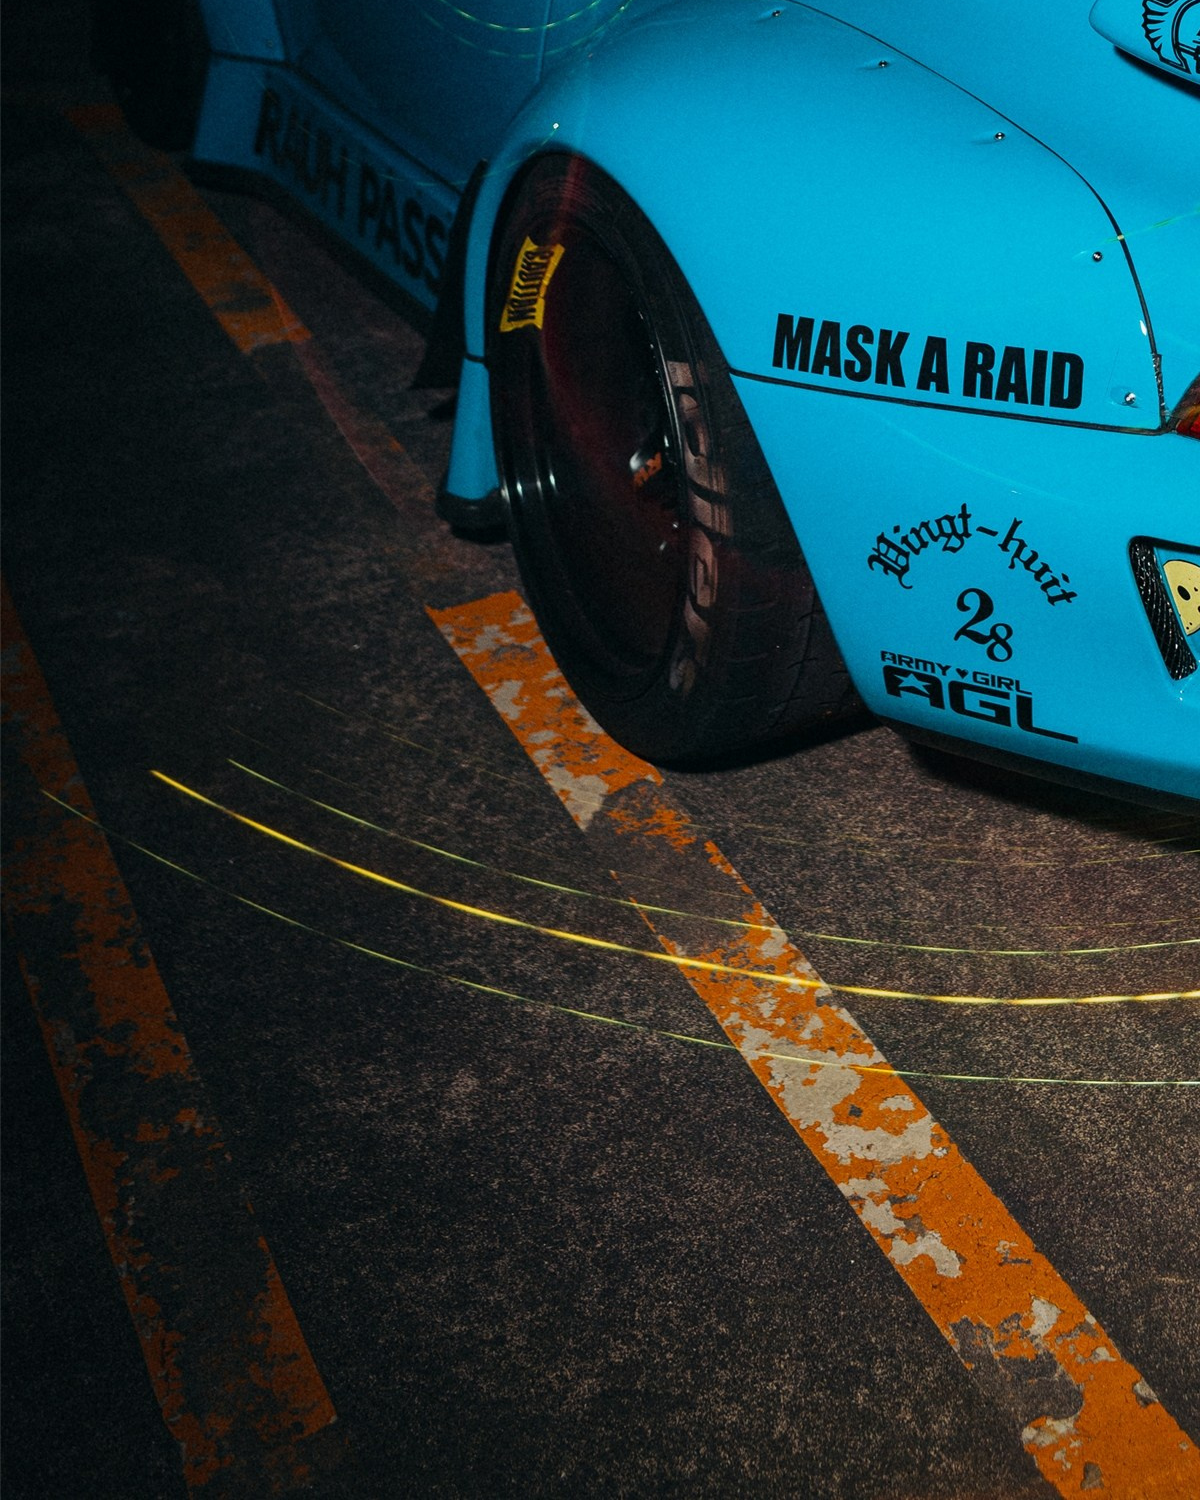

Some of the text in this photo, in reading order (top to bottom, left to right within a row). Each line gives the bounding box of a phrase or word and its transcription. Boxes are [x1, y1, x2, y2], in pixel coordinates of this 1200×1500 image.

[772, 313, 1085, 410] MASK A RAID
[867, 502, 1078, 607] Vingt-huit
[953, 587, 1013, 662] 28
[880, 649, 1034, 696] ARMY GIRL
[883, 664, 1079, 744] AGL
